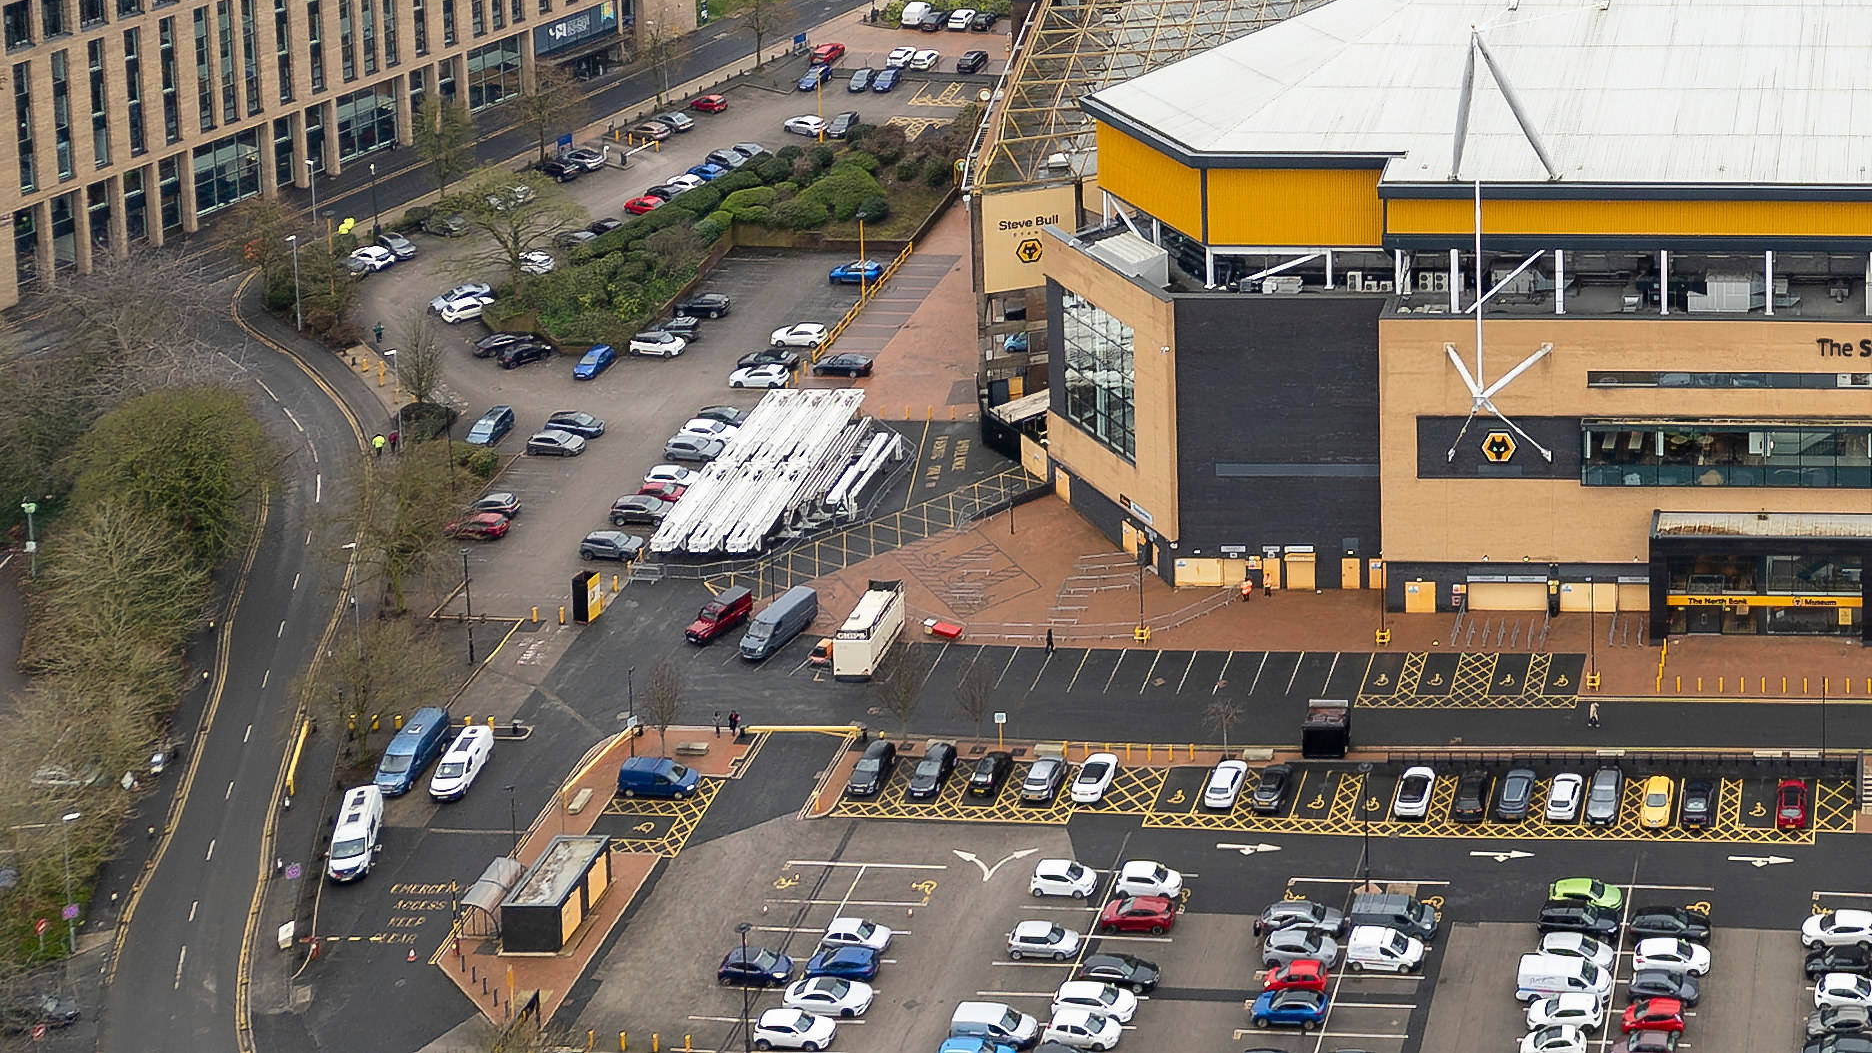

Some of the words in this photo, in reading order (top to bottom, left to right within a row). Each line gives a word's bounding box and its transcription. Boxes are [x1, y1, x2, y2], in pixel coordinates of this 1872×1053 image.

[999, 220, 1032, 231] Steve
[1036, 214, 1058, 226] Bull
[1816, 338, 1853, 357] The
[1804, 598, 1836, 606] Museum
[393, 899, 447, 911] ACCESS
[387, 916, 426, 927] KEEP
